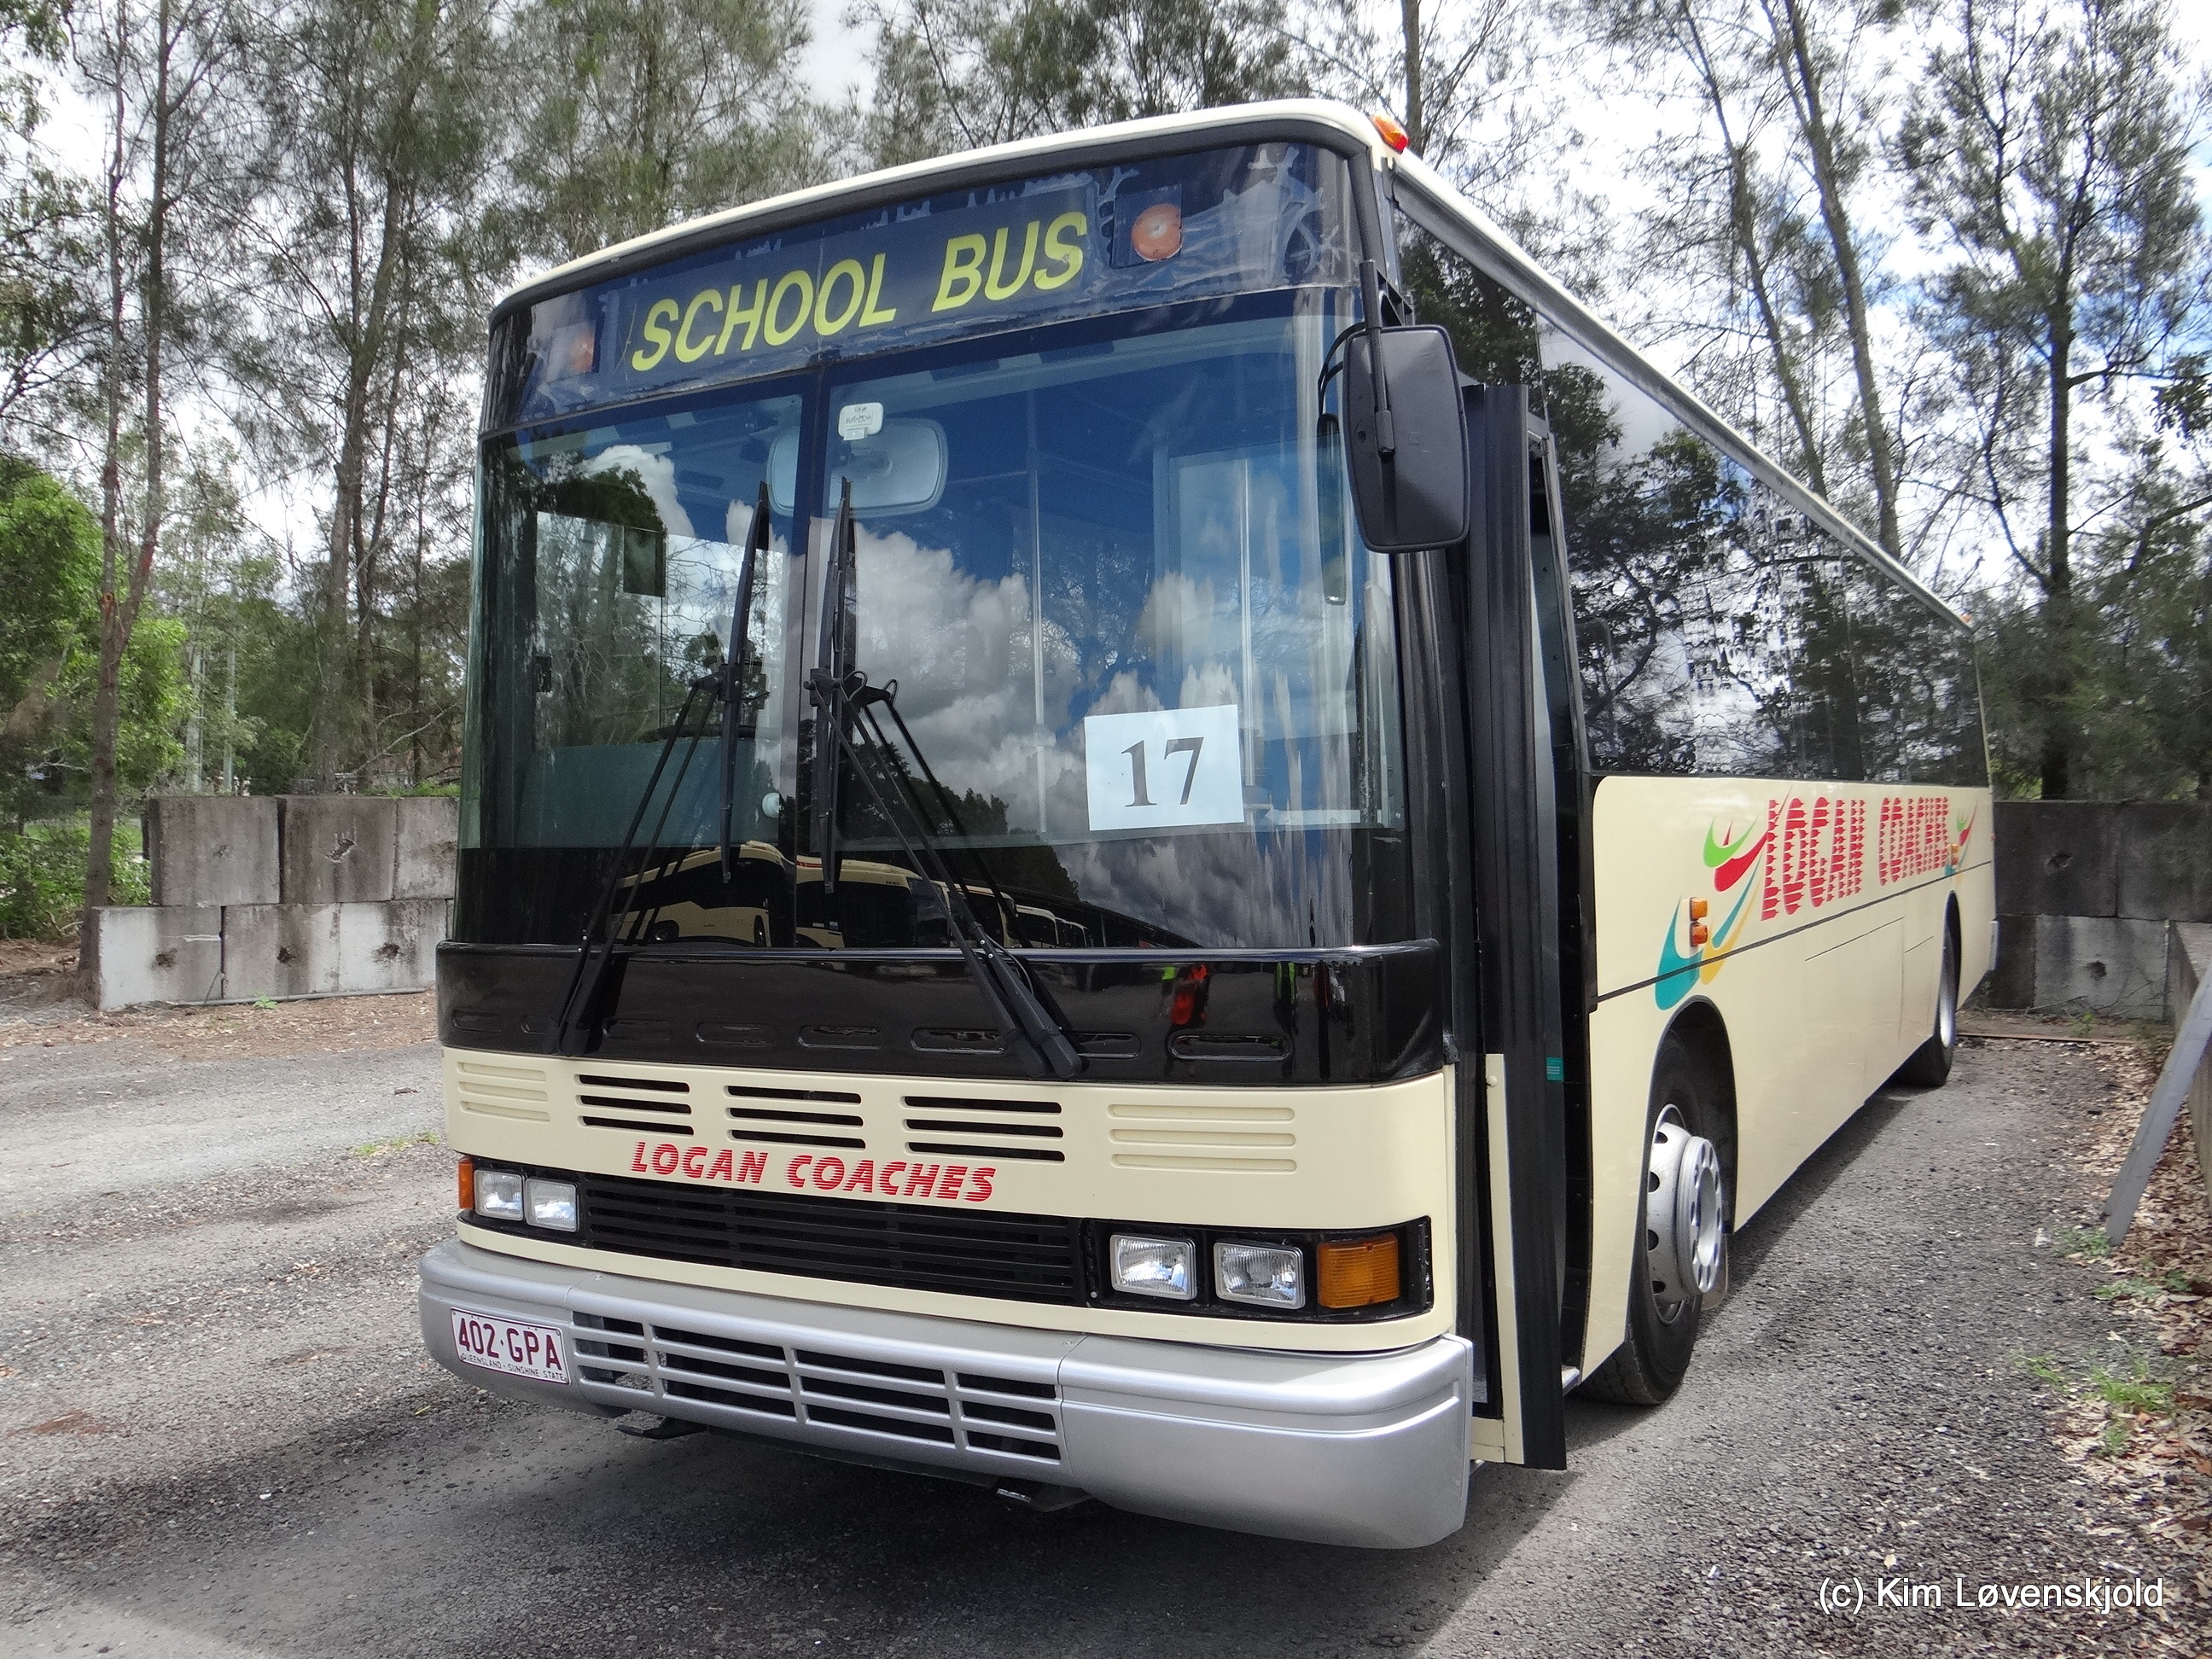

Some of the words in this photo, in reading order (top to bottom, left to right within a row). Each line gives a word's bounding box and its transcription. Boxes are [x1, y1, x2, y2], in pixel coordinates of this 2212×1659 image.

[632, 253, 897, 372] SCHOOL
[931, 211, 1089, 313] BUS
[1121, 736, 1204, 807] 17
[1760, 795, 1866, 922] LOGAN
[630, 1142, 768, 1185] LOGAN
[784, 1155, 997, 1203] COACHES
[461, 1353, 502, 1370] QUEENSLAND
[507, 1363, 540, 1377] SUNSHINE
[543, 1370, 565, 1382] STATE
